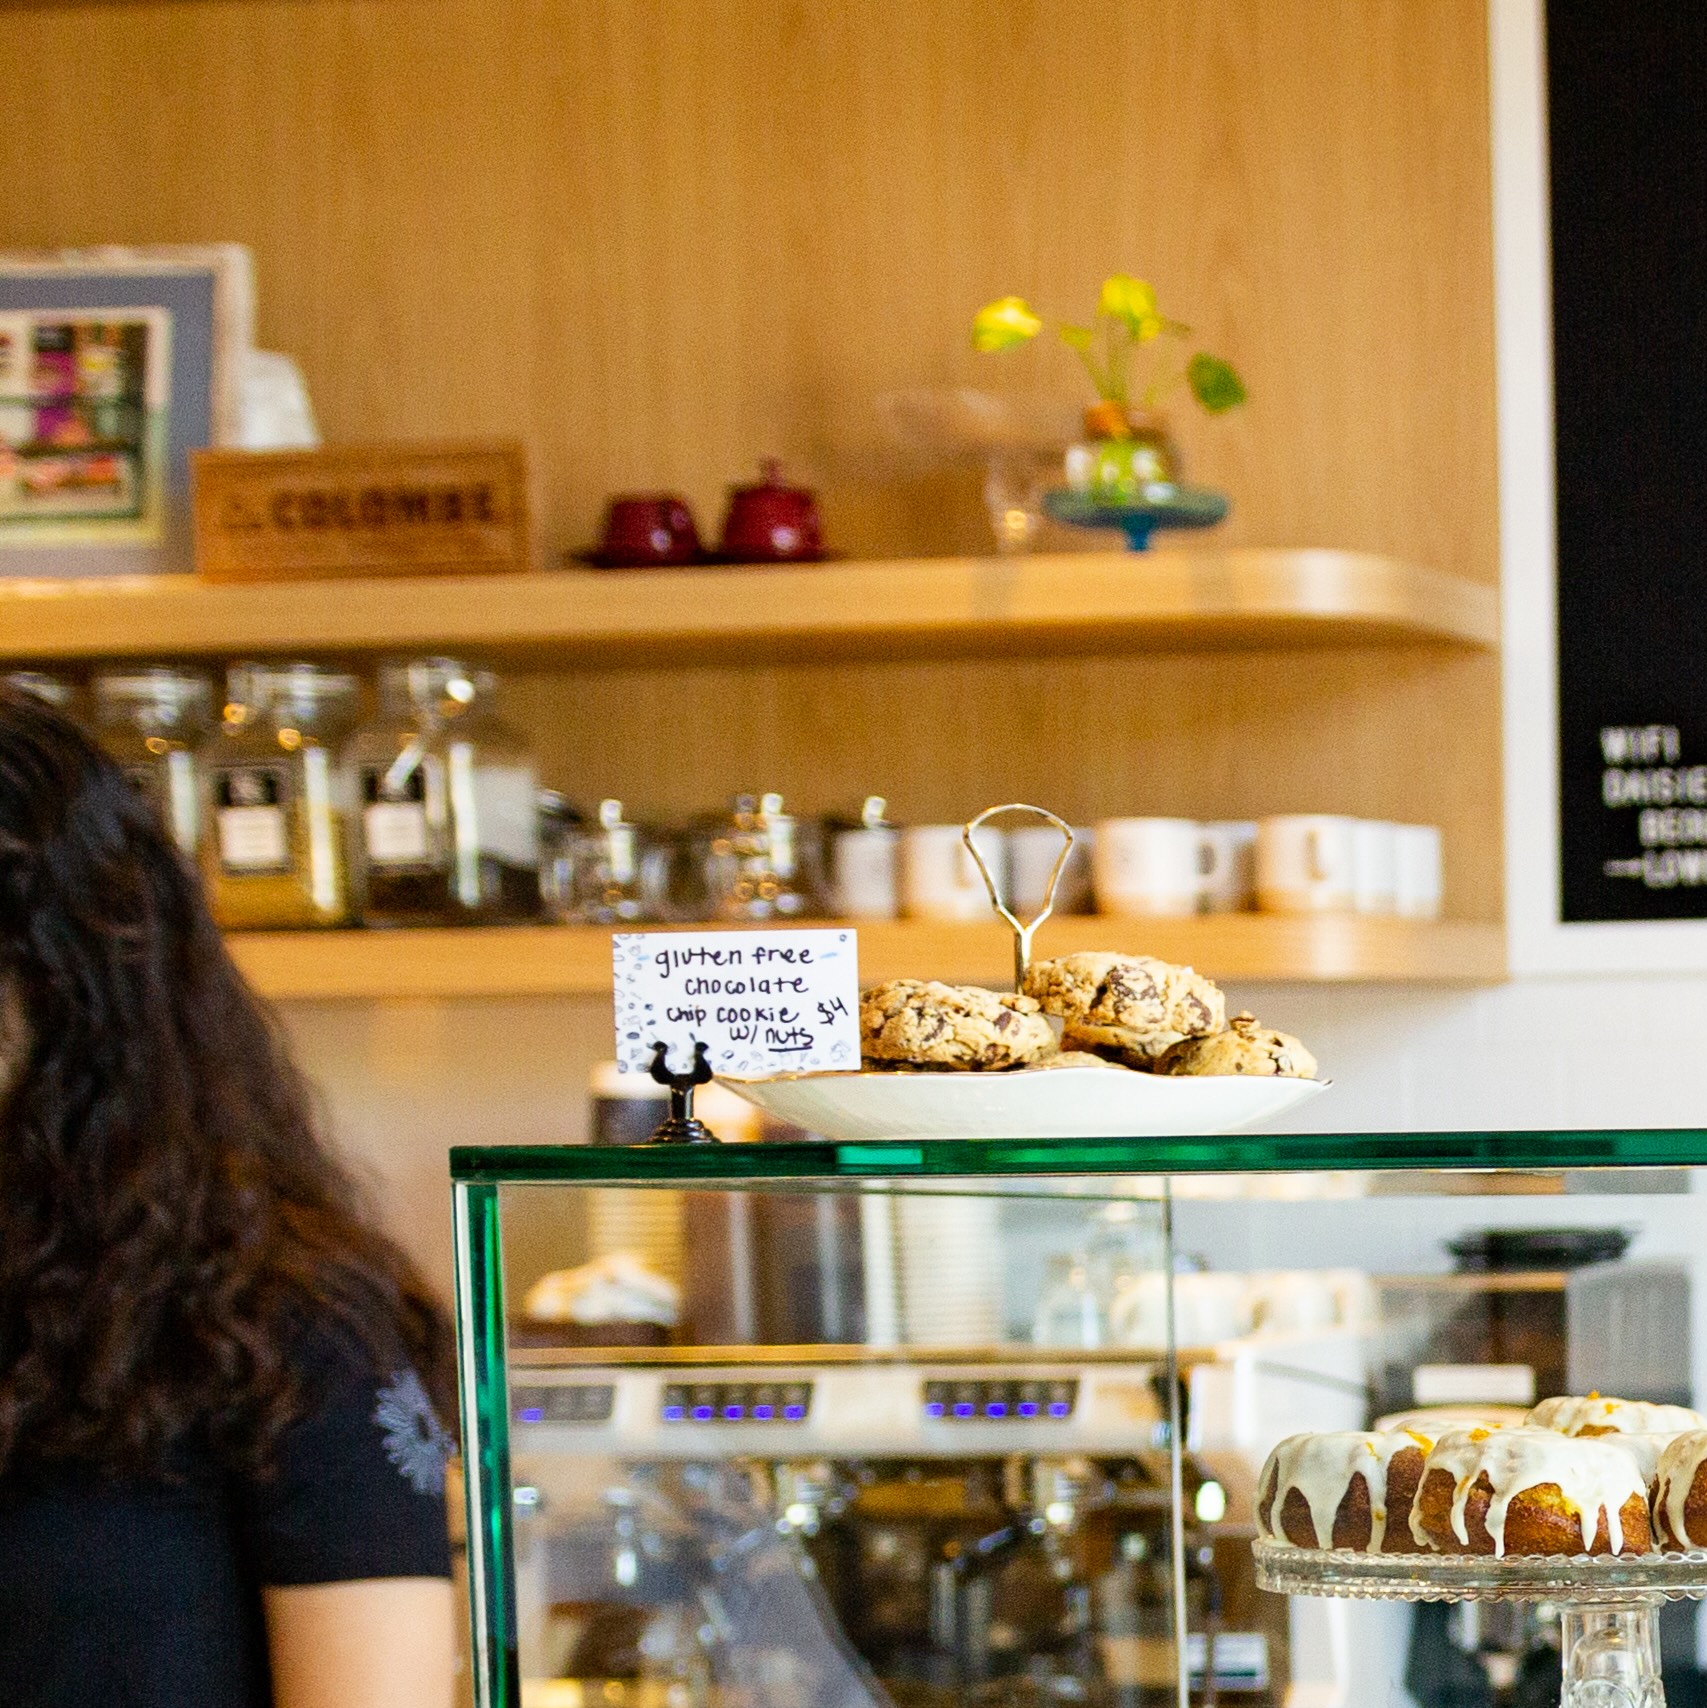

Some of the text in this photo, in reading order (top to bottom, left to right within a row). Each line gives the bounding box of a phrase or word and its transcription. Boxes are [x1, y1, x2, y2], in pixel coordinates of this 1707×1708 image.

[1600, 725, 1681, 764] WIFI
[656, 946, 814, 978] gluten free
[685, 976, 809, 995] chocolate
[667, 996, 849, 1027] chip cookie $4
[765, 1026, 814, 1046] nuts
